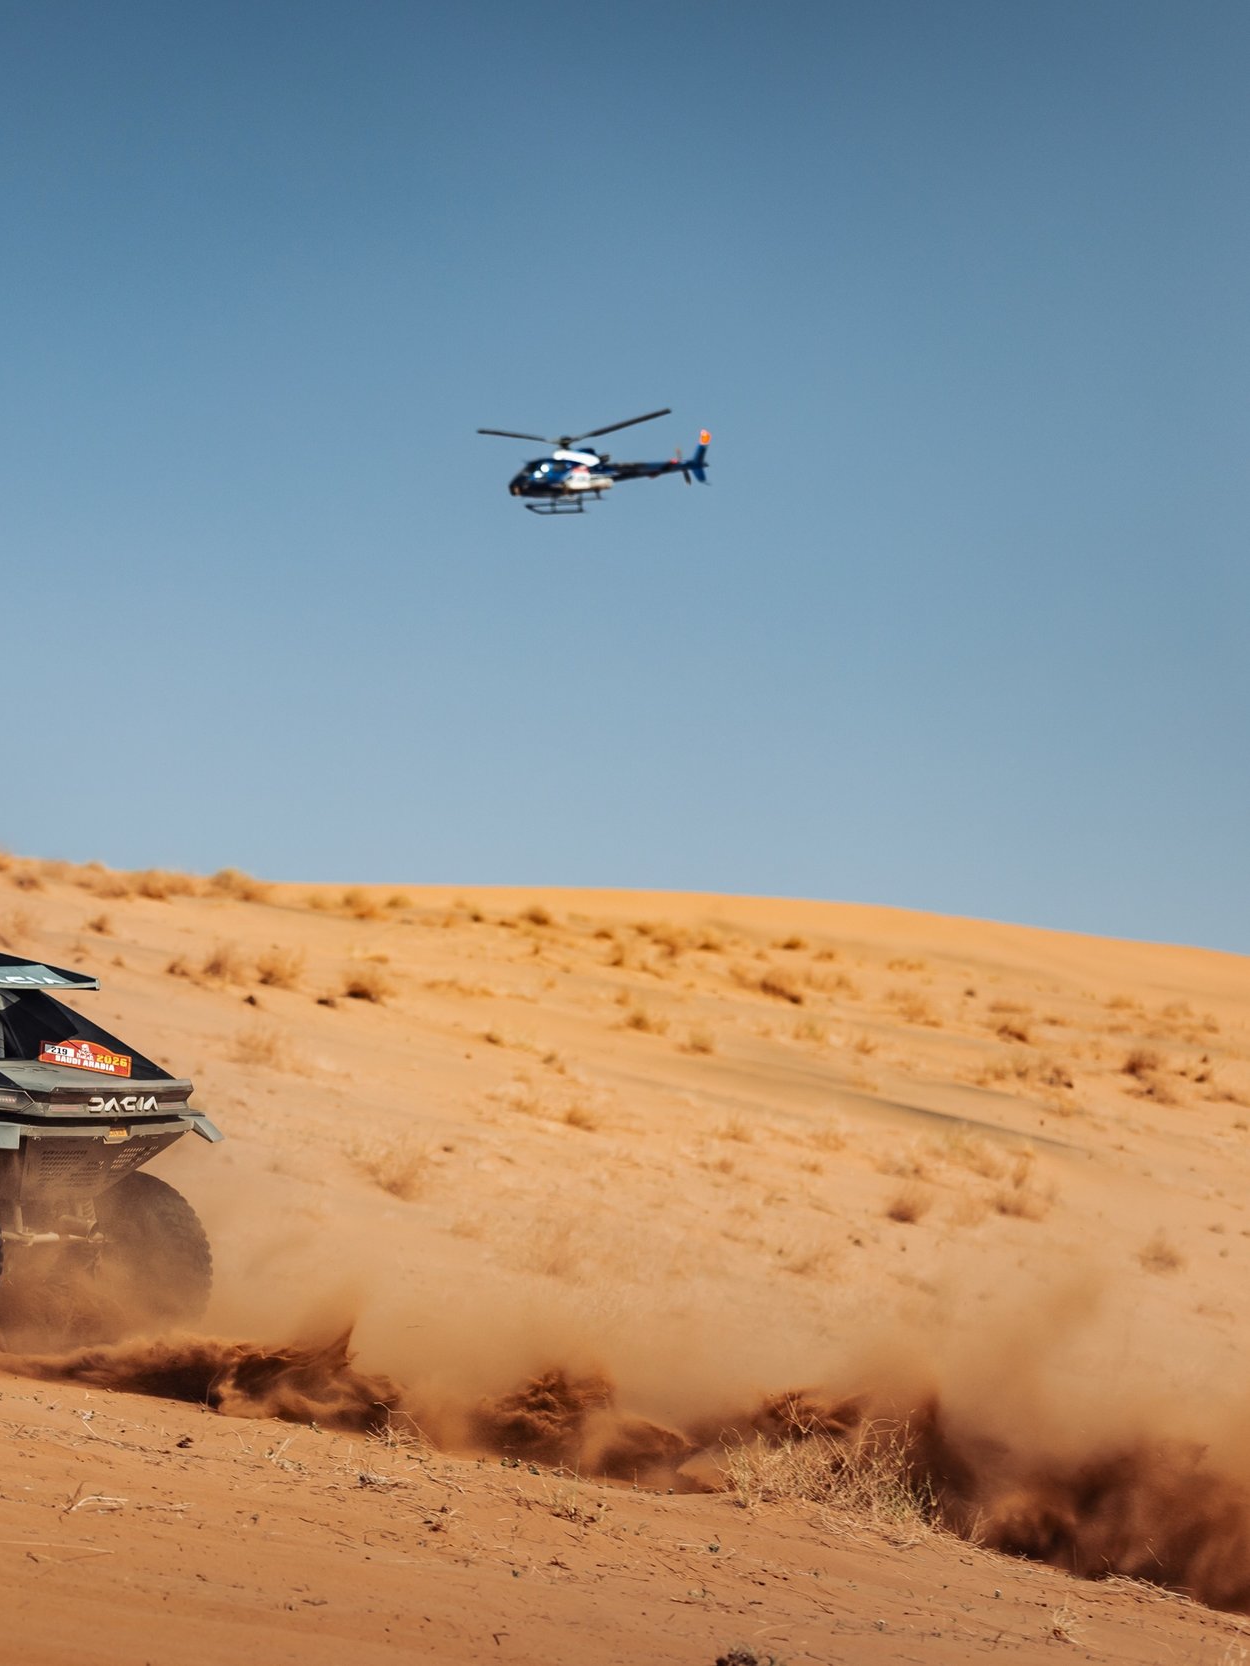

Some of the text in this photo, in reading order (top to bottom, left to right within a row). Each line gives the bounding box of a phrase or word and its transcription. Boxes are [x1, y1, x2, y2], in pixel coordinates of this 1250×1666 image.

[50, 1046, 68, 1056] 219
[55, 1055, 81, 1065] SAUDI
[83, 1060, 115, 1072] ARABIA
[96, 1054, 127, 1067] 2026
[88, 1096, 158, 1112] DACIA
